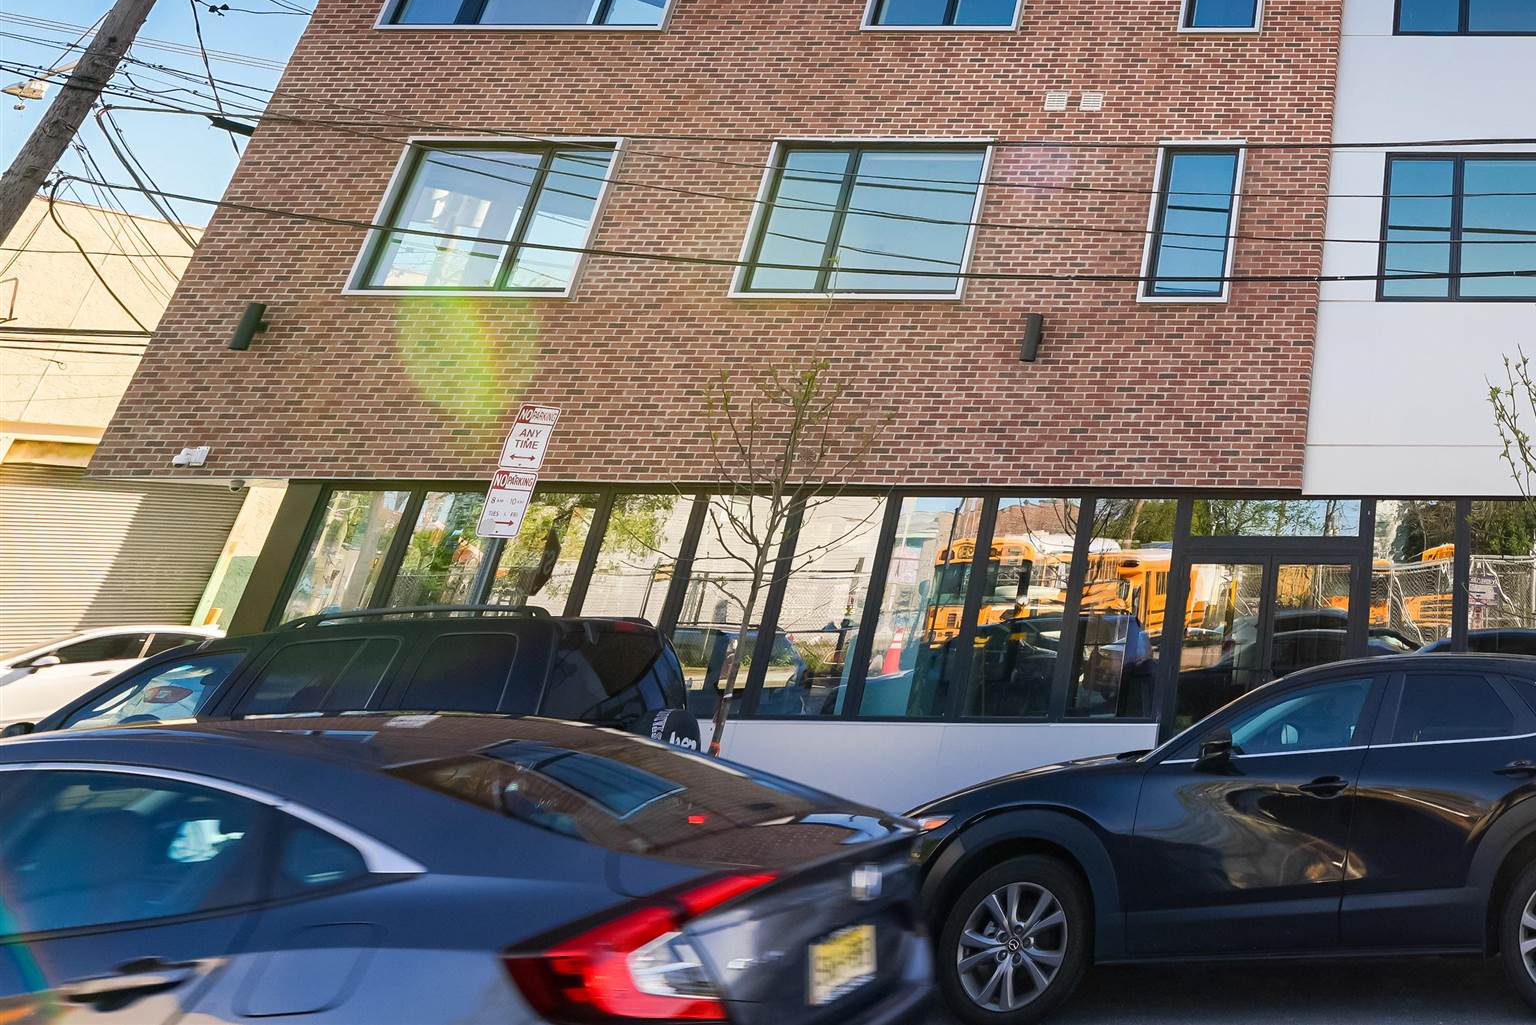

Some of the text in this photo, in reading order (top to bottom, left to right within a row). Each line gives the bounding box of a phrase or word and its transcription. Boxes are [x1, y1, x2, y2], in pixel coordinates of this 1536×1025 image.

[519, 408, 557, 422] NO PARKING
[519, 428, 543, 438] ANY
[515, 439, 540, 450] TIME
[494, 473, 533, 487] NO PARKING
